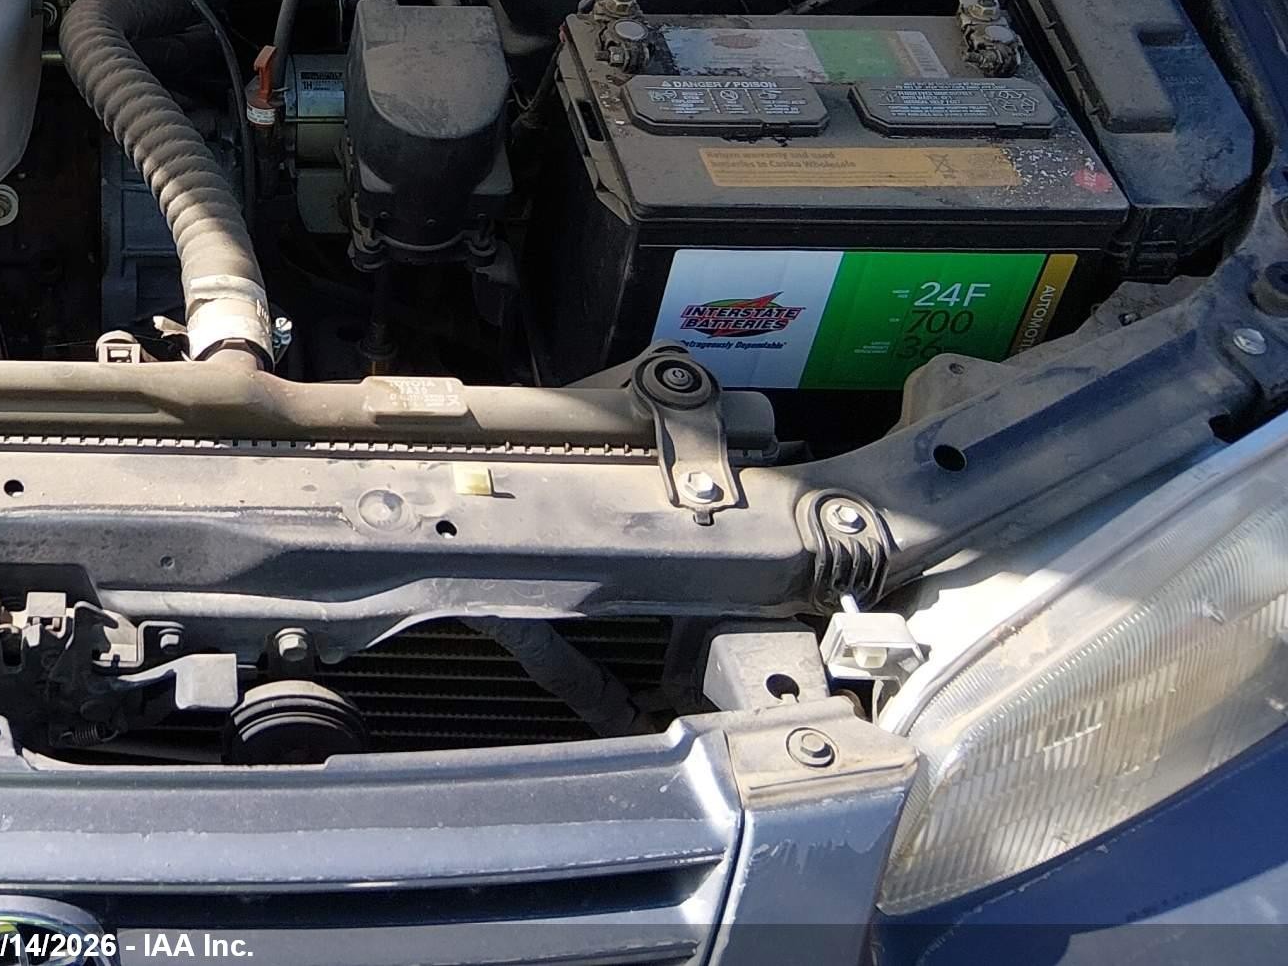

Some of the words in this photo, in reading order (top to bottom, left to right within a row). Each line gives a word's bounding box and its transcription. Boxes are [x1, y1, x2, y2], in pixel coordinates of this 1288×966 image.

[675, 80, 721, 88] DANGER
[732, 80, 778, 88] POISON
[913, 281, 991, 307] 24F
[685, 307, 799, 318] INTERSTATE
[905, 309, 974, 334] 700
[1016, 284, 1057, 351] AUTOMOTI
[684, 318, 789, 330] BATTERIES
